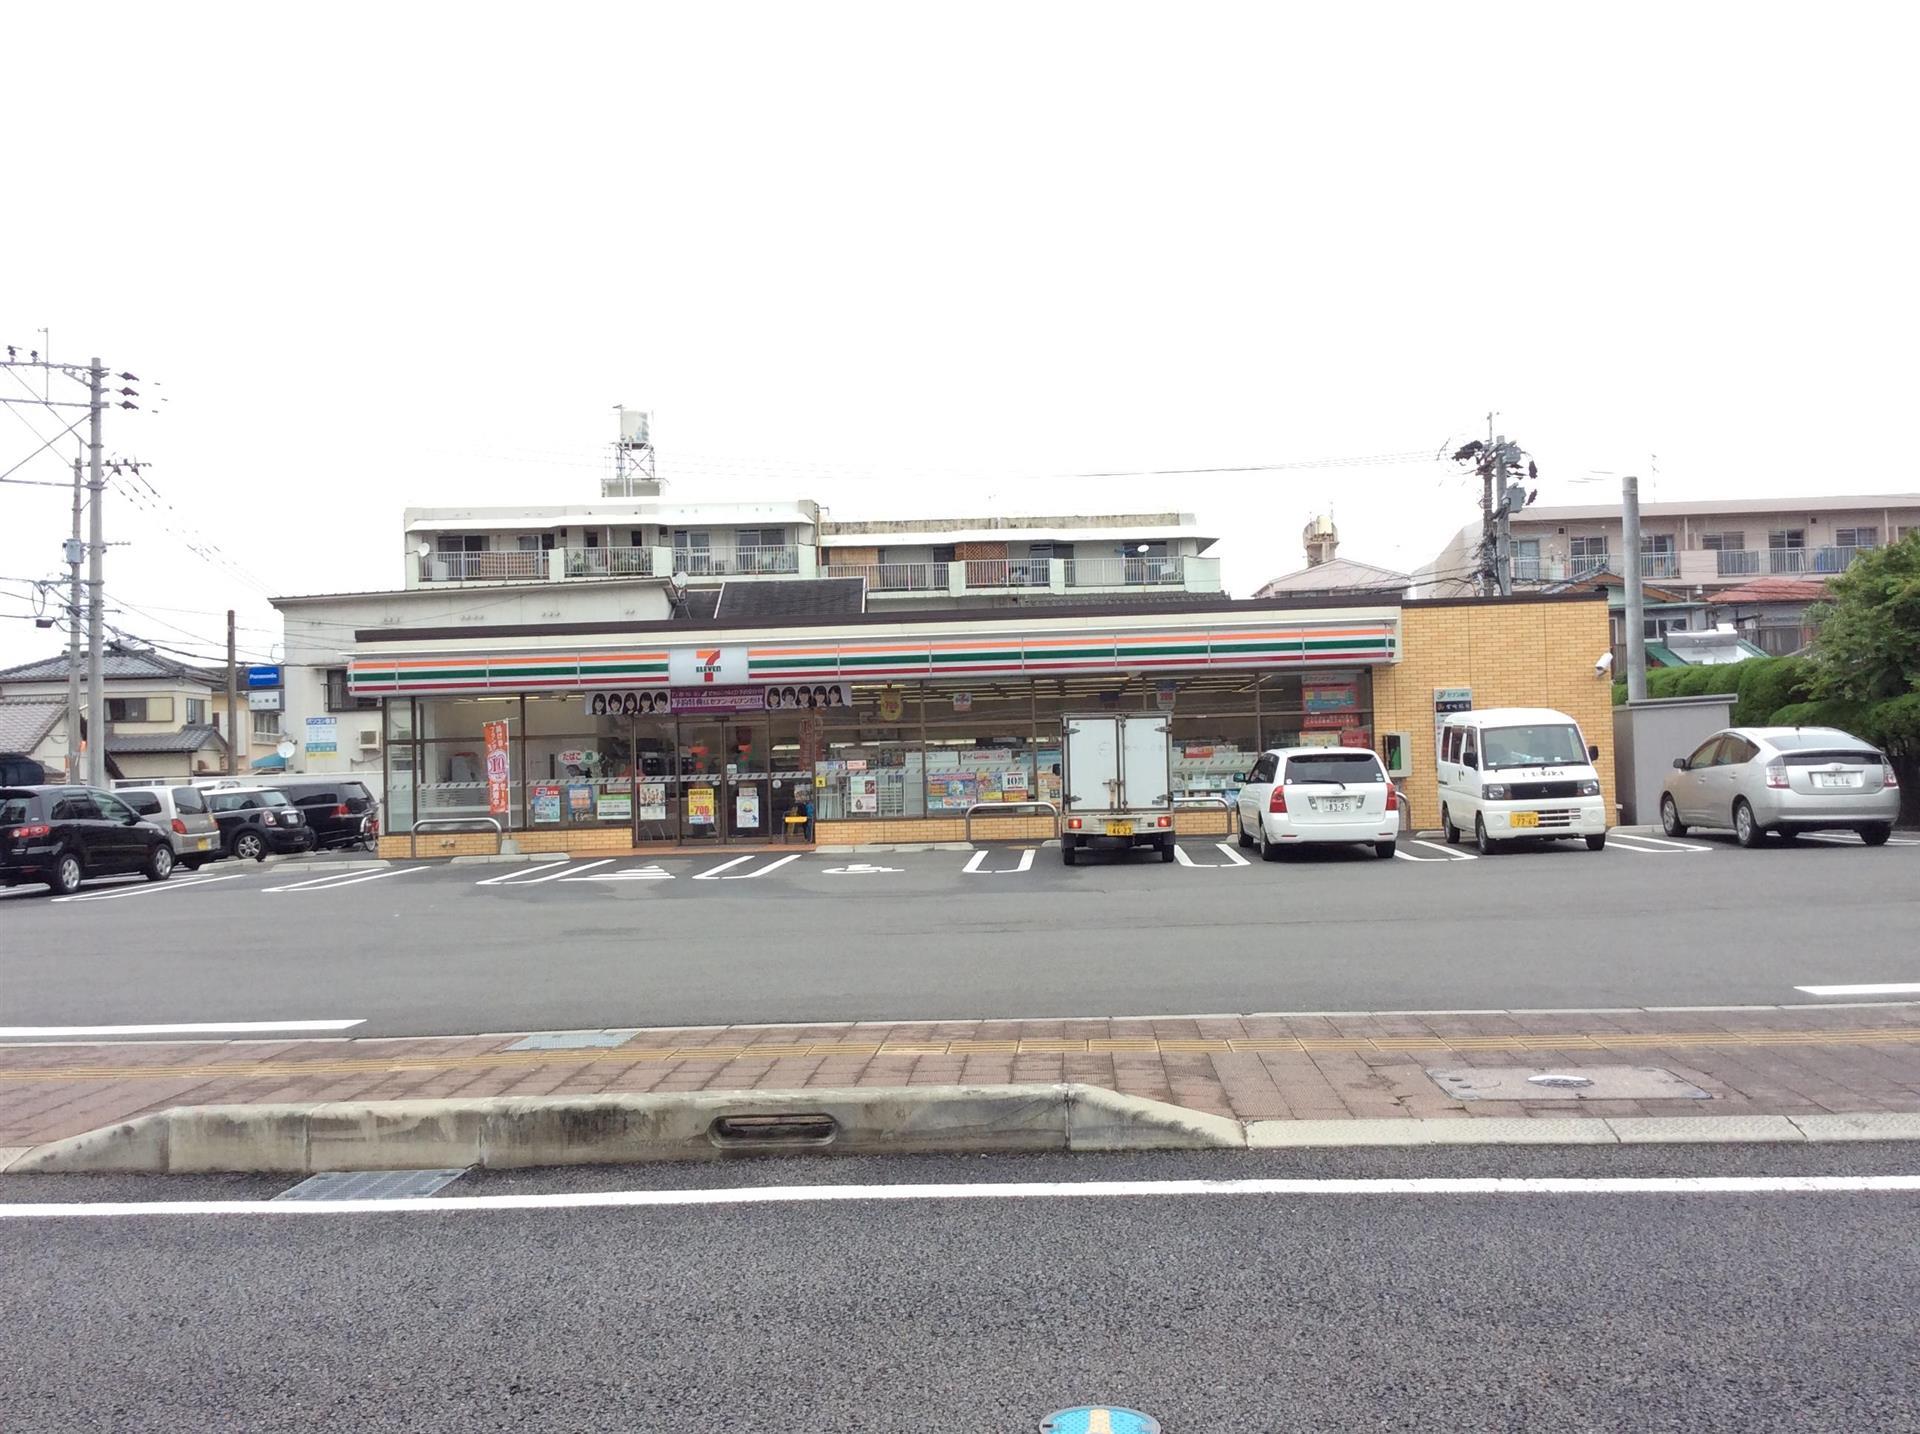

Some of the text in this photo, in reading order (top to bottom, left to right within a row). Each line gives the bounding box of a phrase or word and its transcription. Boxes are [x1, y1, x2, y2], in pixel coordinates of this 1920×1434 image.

[696, 650, 720, 682] 7
[562, 752, 581, 760] たばこ
